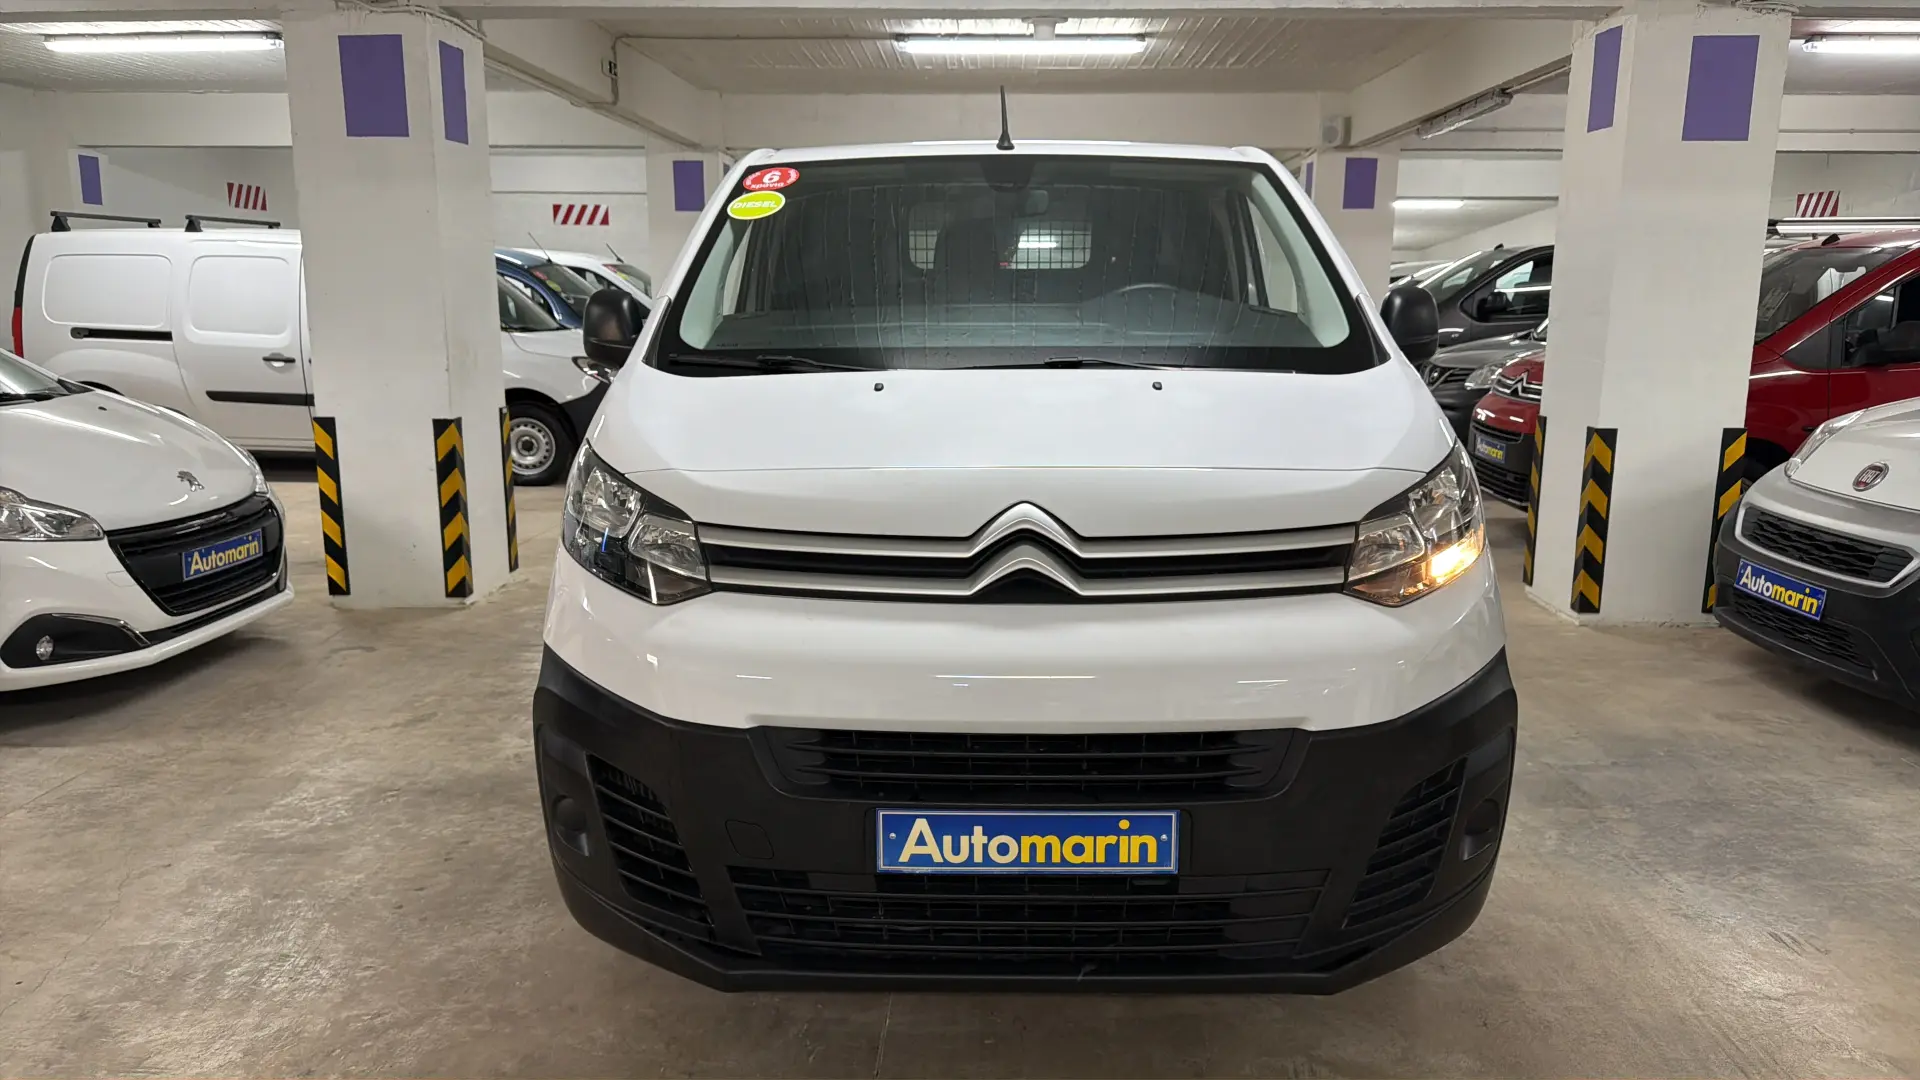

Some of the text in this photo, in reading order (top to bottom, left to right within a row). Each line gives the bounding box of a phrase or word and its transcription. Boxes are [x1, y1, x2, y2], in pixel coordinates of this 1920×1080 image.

[762, 170, 781, 184] 6
[732, 201, 778, 209] DIESEL
[189, 535, 259, 576] Automarin
[1739, 565, 1819, 615] Automarin
[898, 818, 1158, 864] Automarin
